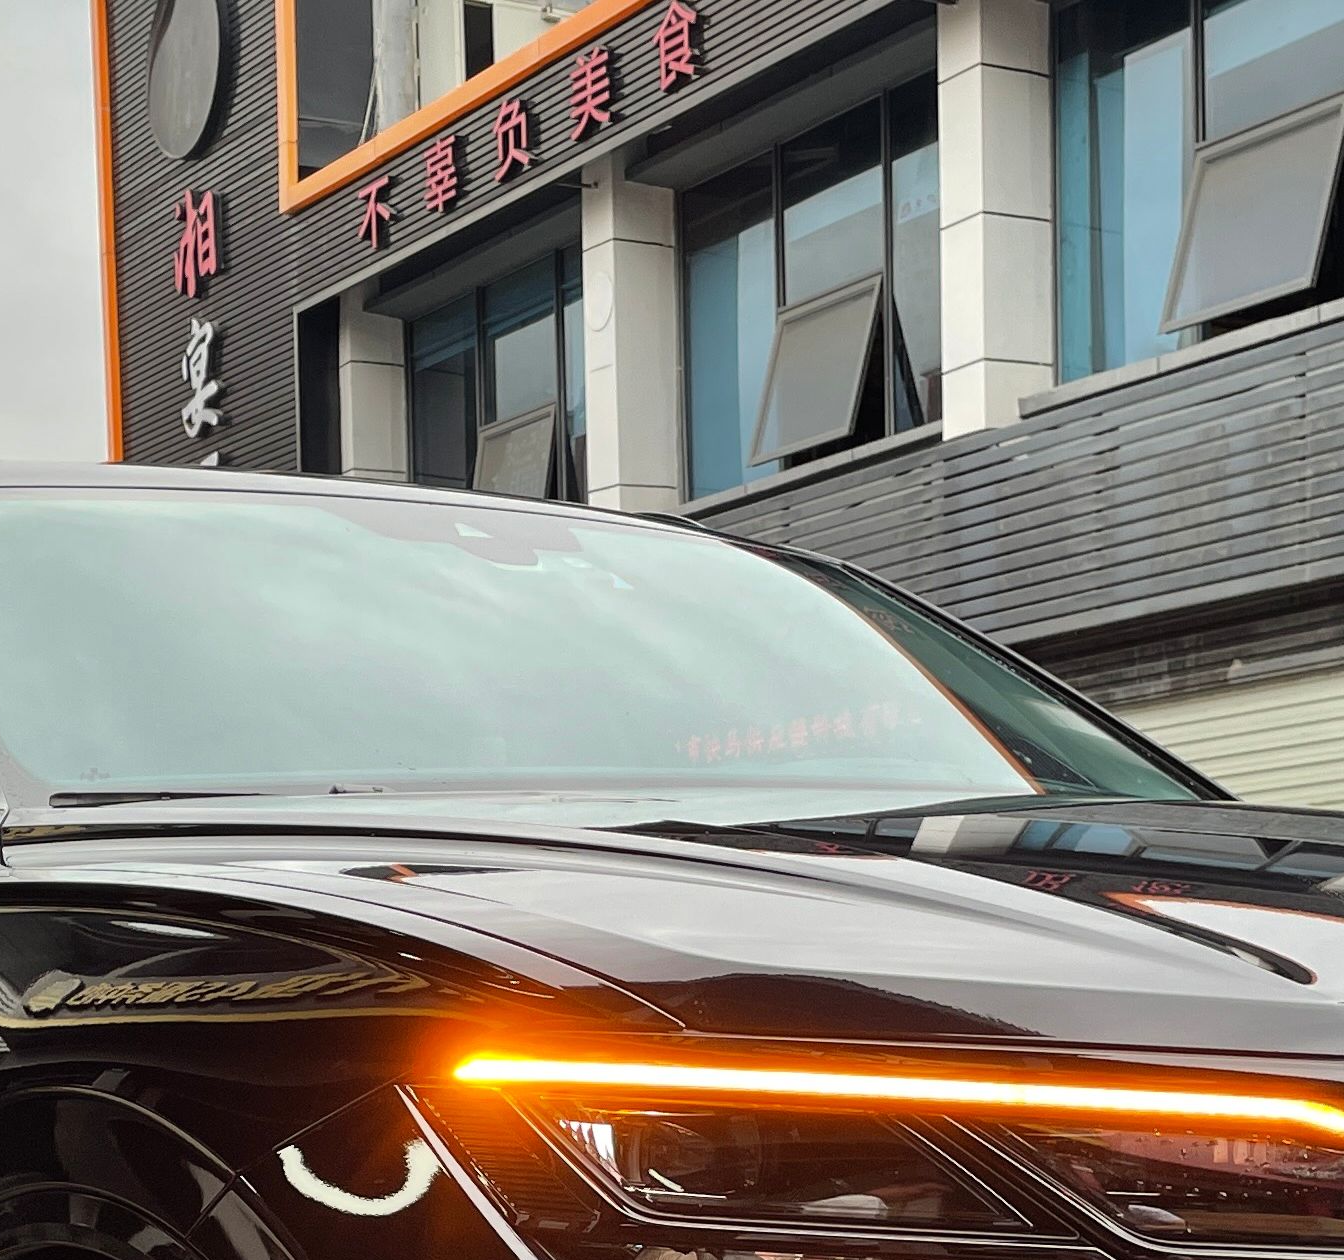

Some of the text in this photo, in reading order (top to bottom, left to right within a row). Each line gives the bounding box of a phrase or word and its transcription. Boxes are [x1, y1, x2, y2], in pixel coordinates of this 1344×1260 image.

[358, 1, 697, 250] 不辜负美食
